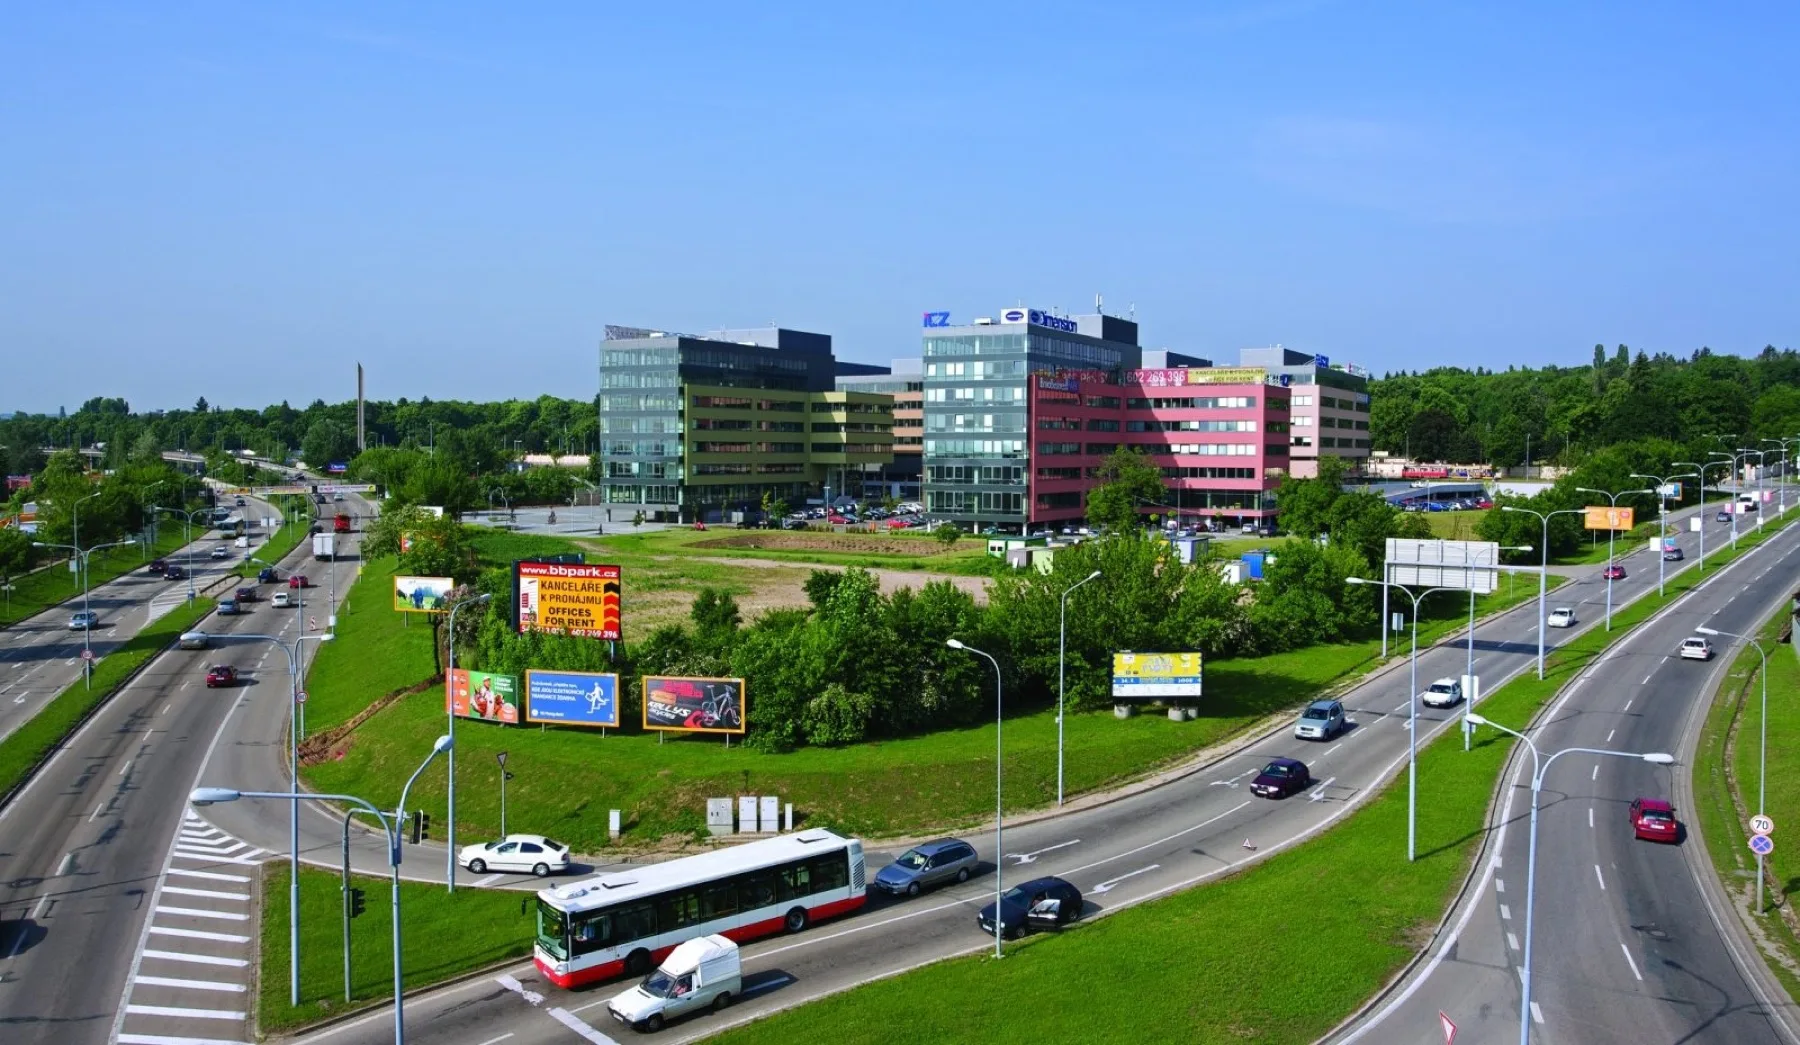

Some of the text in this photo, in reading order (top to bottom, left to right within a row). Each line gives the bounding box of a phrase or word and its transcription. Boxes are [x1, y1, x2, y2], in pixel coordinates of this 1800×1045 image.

[1040, 311, 1078, 333] Dimension
[1127, 371, 1144, 383] 602
[1148, 371, 1164, 383] 269
[1167, 370, 1185, 383] 396
[521, 565, 618, 578] www.bbpark.cz
[540, 580, 602, 593] KANCELÁŘE
[540, 593, 602, 605] K PRONÁJMU
[548, 606, 592, 617] OFFICES
[545, 616, 596, 628] FOR RENT
[603, 630, 618, 639] 396
[1755, 819, 1769, 830] 70
